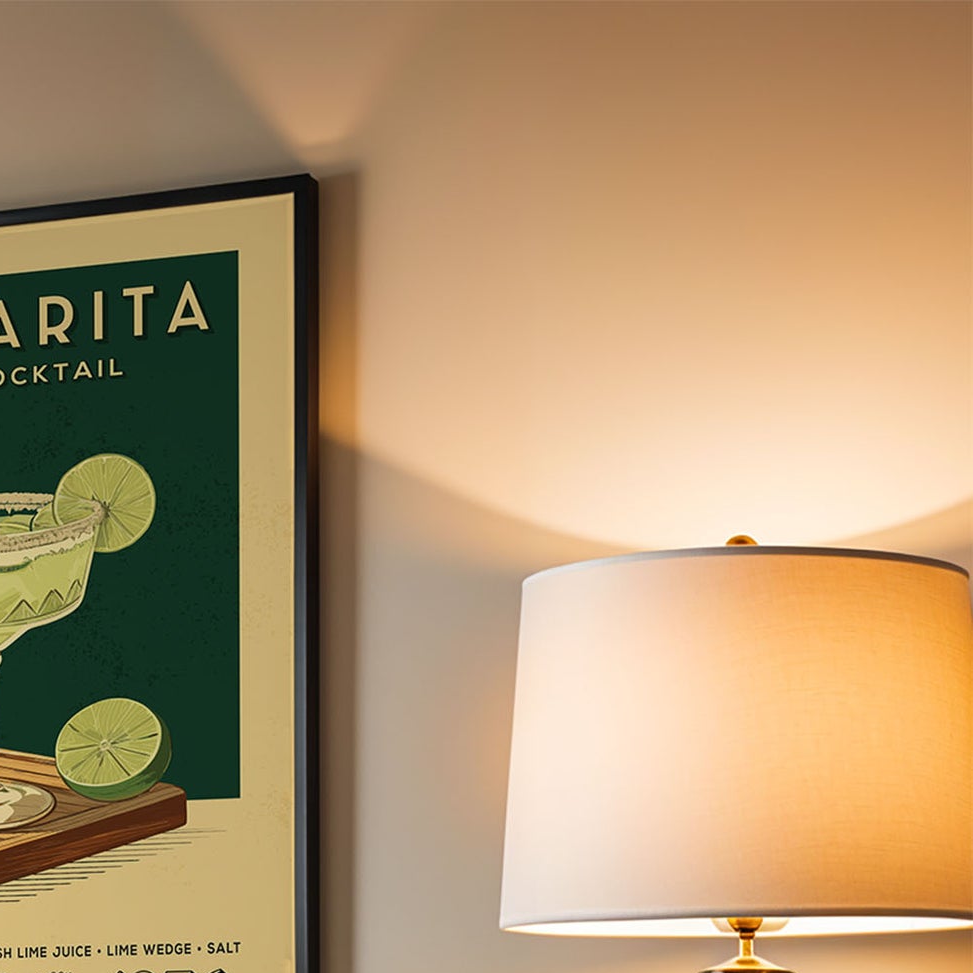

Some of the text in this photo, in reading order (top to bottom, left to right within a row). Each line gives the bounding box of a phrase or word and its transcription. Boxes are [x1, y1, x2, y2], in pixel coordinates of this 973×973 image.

[17, 946, 47, 958] LIME
[52, 945, 92, 958] JUICE
[106, 944, 138, 957] LIME
[143, 943, 192, 955] WEDGE
[207, 941, 241, 954] SALT
